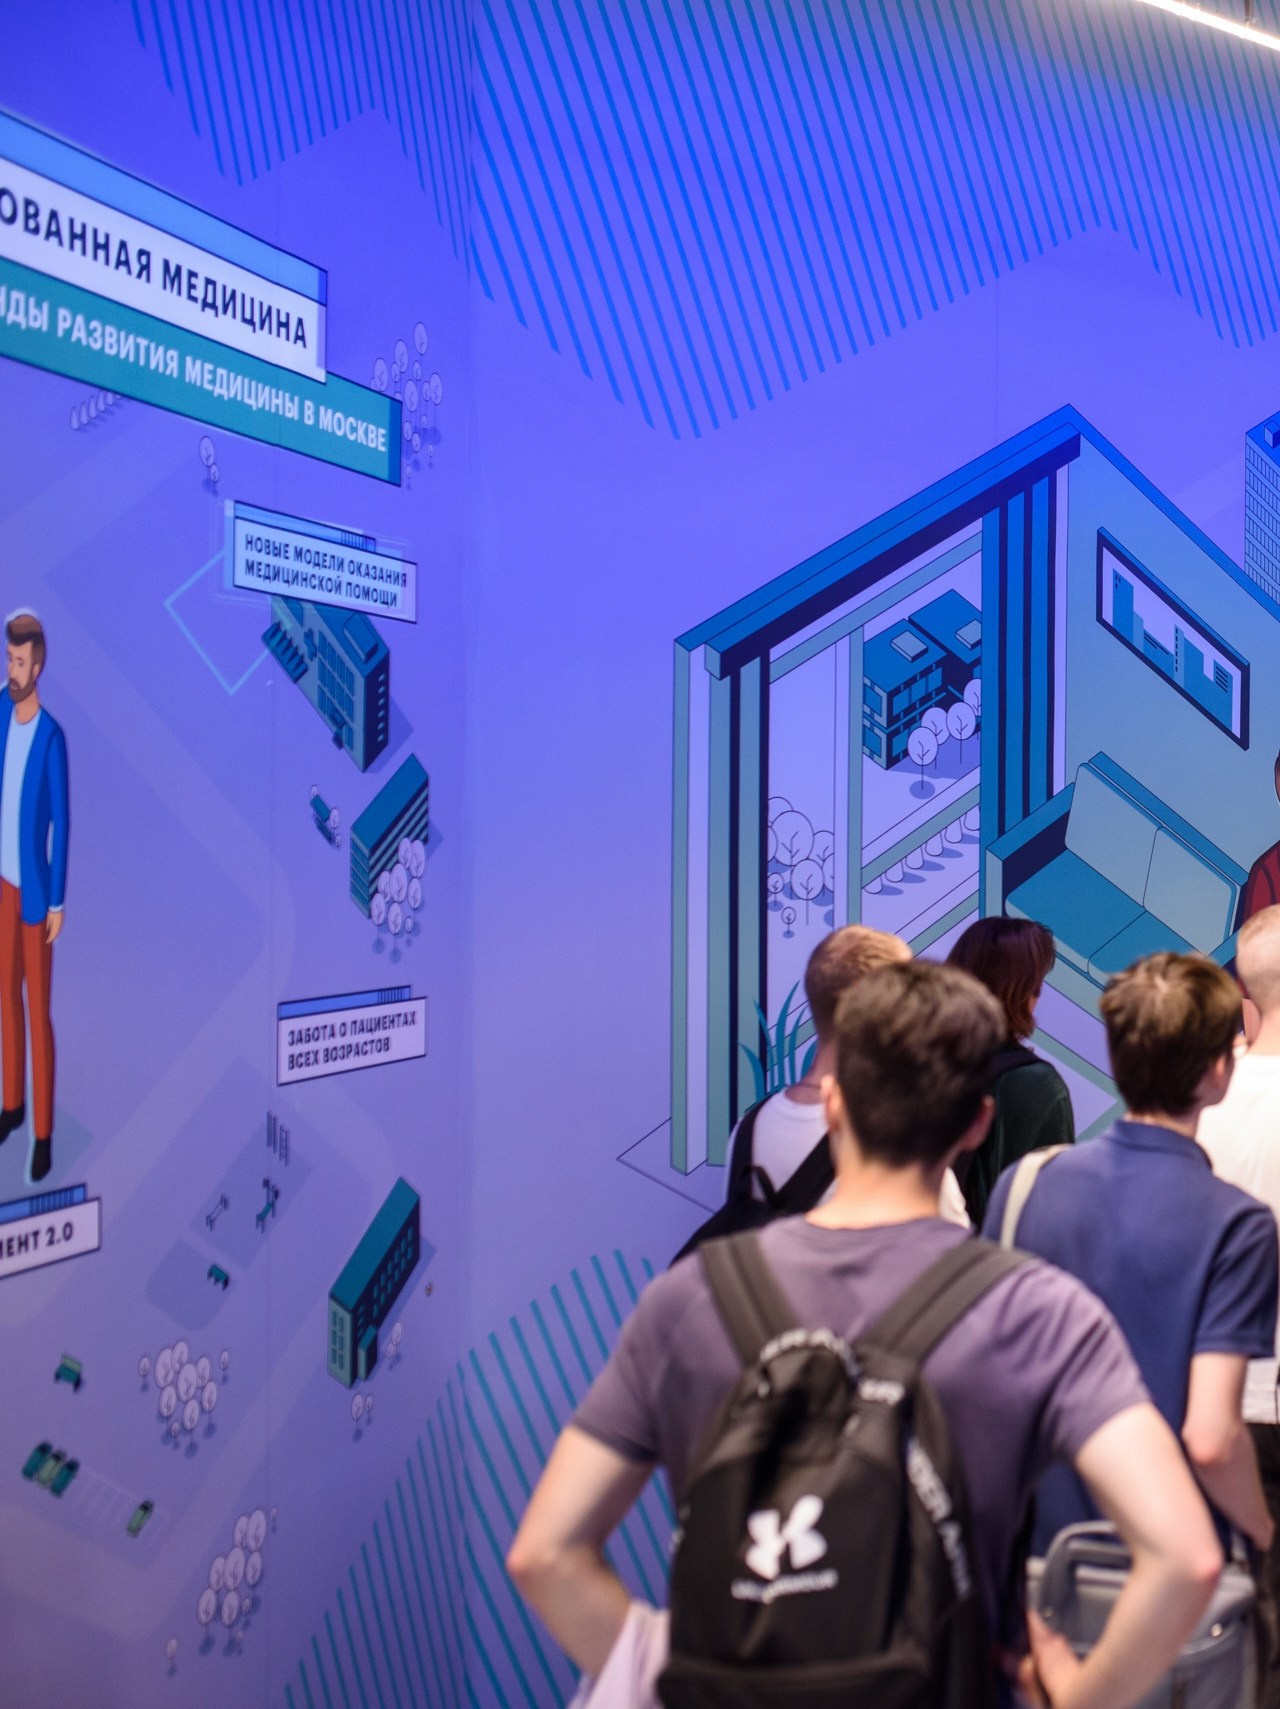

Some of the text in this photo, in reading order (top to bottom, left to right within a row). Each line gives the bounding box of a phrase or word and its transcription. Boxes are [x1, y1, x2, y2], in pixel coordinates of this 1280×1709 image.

[0, 186, 308, 350] ОВАННАЯ МЕДИЦИНА
[57, 306, 179, 378] РАЗВИТИЯ
[185, 355, 299, 421] МЕДИЦИНЫ
[303, 399, 315, 426] В
[319, 404, 387, 453] МОСКВЕ
[244, 533, 407, 589] НОВЫЕ МОДЕЛИ ОКАЗАНИЯ
[244, 558, 398, 608] МЕДИЦИНСКОЙ ПОМОЩИ
[287, 1036, 391, 1071] ВСЕХ ВОЗРАСТОВ
[288, 1010, 417, 1047] ЗАБОТА О ПАЦИЕНТАХ
[0, 1220, 74, 1259] ЕНТ 2.0
